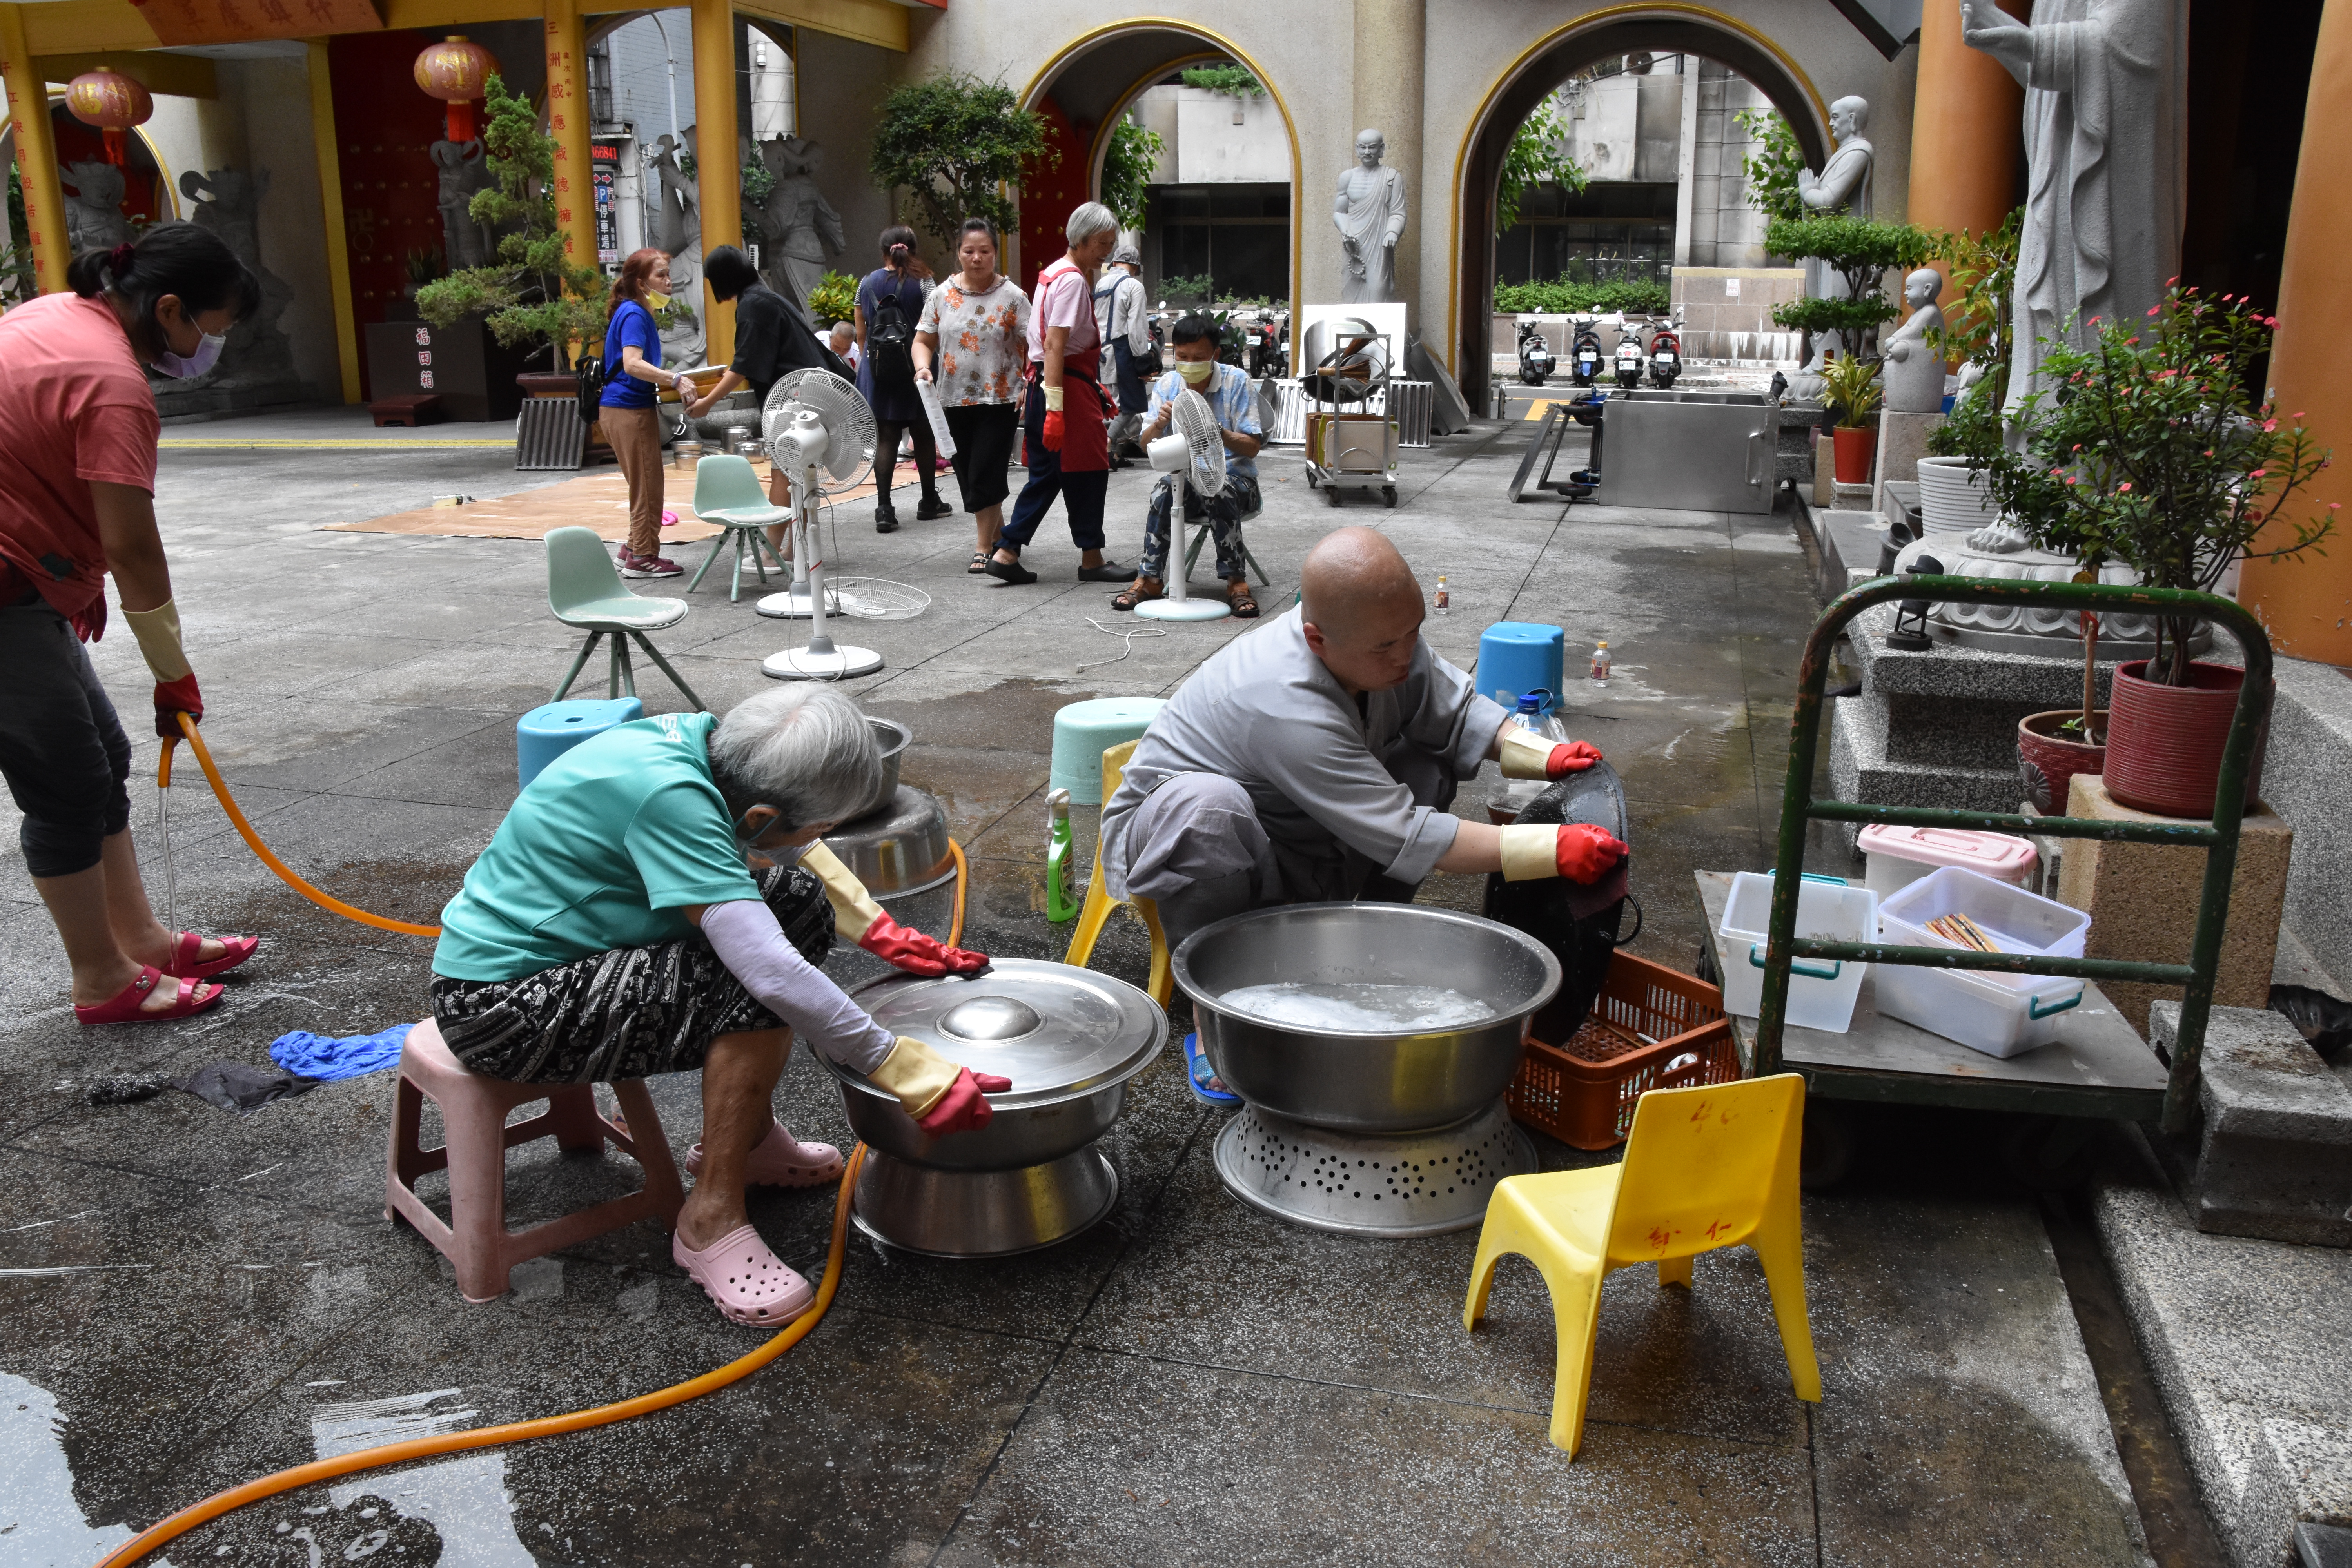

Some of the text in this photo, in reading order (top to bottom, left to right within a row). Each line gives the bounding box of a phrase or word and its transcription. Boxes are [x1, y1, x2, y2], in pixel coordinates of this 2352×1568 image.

[599, 188, 606, 200] P
[607, 187, 615, 212] 汽車
[600, 204, 610, 249] 停車場
[416, 328, 434, 388] 福田箱
